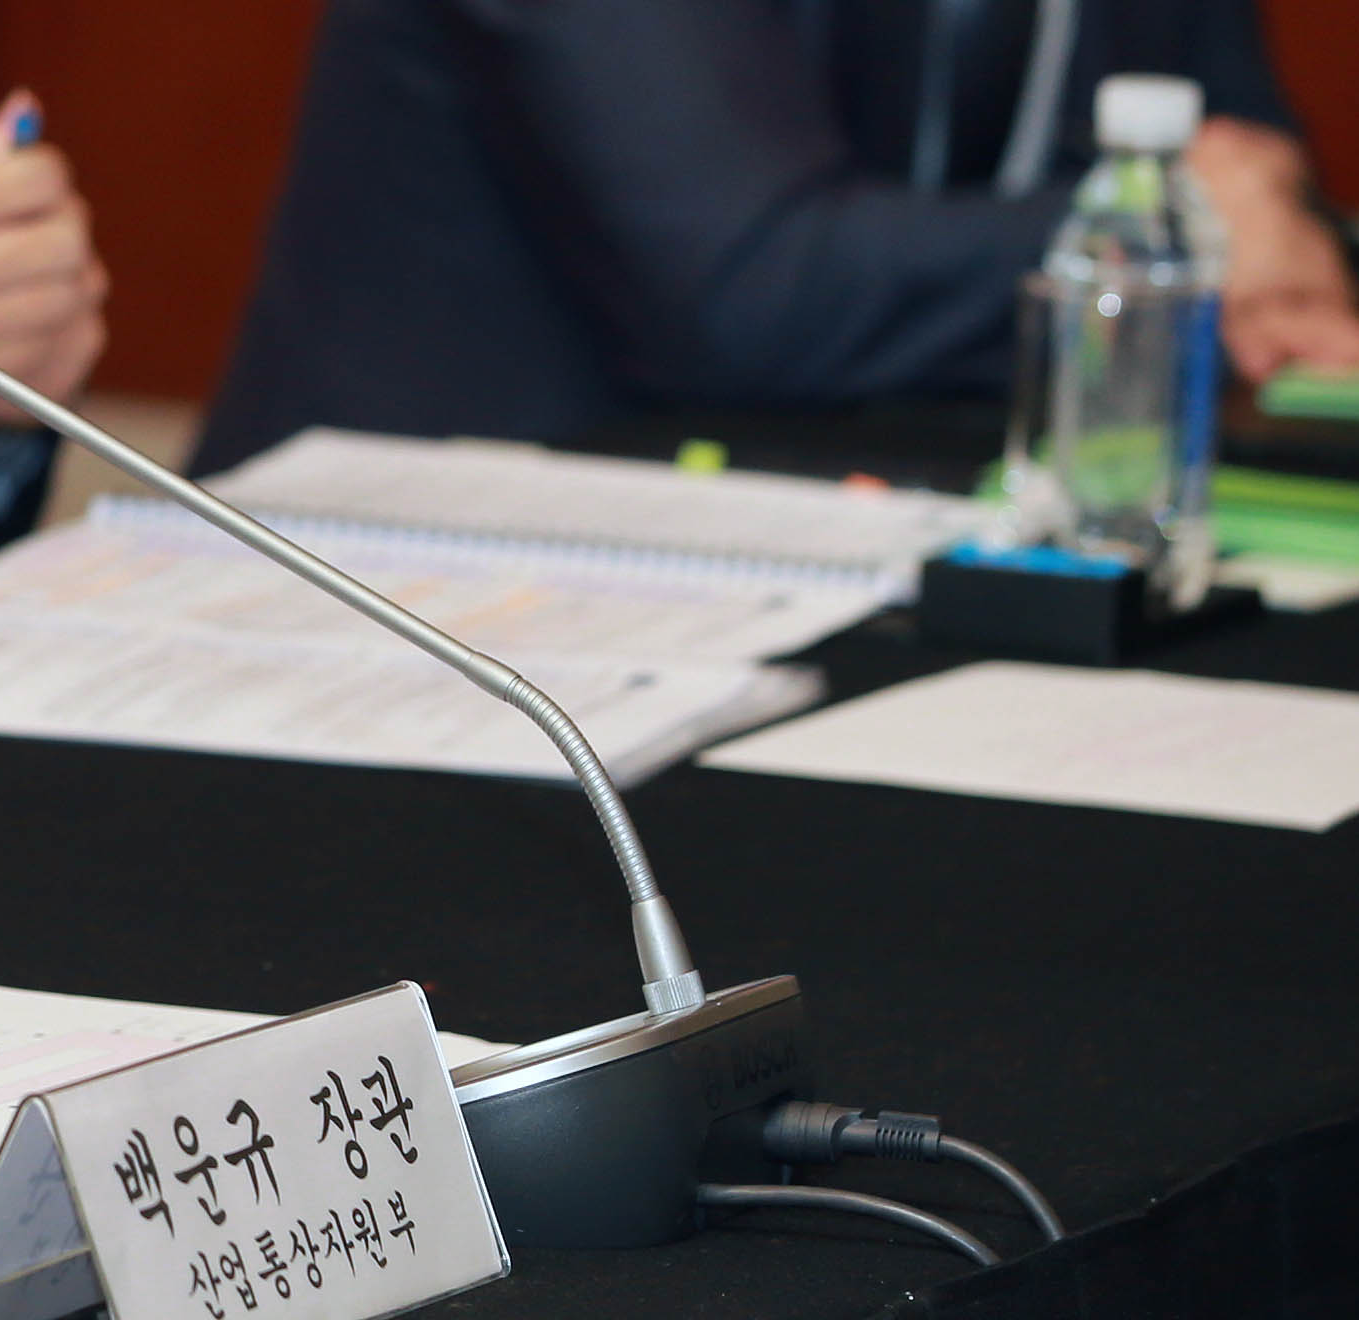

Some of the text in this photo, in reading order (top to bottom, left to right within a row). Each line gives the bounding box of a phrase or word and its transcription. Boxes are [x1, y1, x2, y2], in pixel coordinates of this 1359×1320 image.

[113, 1055, 419, 1240] 백운규 장관
[189, 1190, 416, 1320] 산업통상자원부
